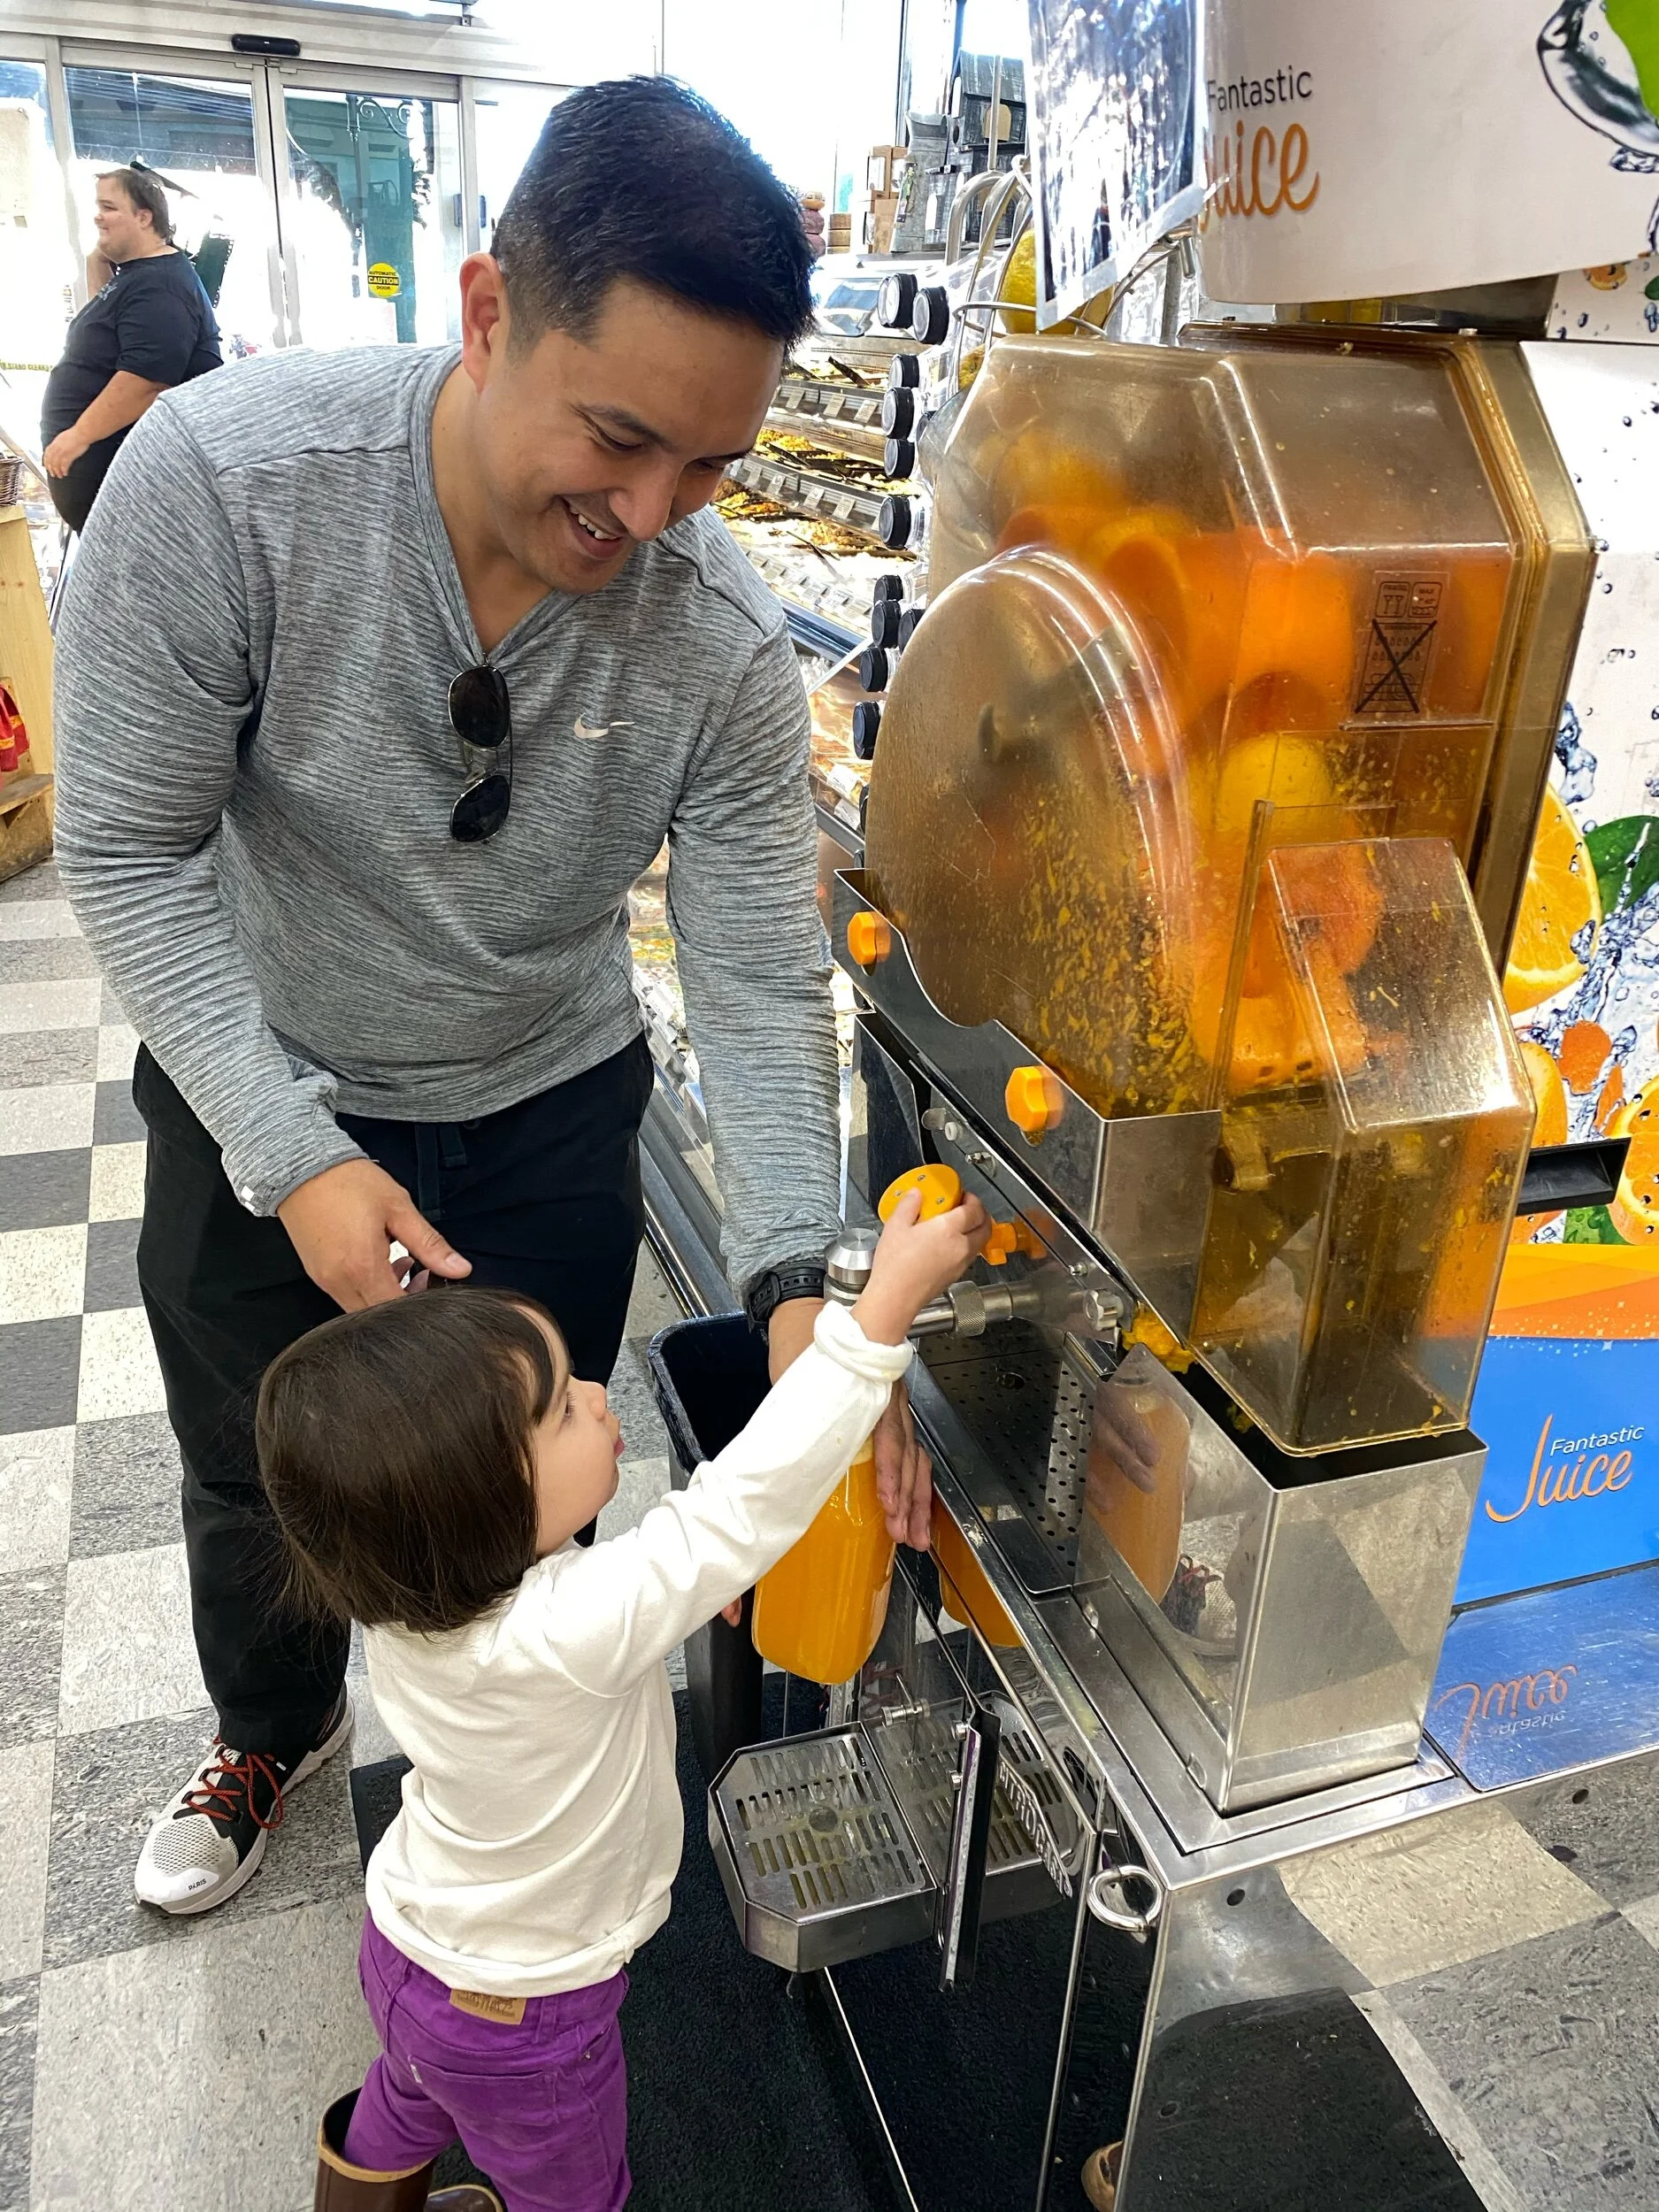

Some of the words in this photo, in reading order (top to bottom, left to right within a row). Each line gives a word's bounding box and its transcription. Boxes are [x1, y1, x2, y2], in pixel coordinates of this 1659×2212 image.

[1207, 65, 1313, 112] Fantastic
[368, 276, 399, 285] CAUTION
[1550, 1425, 1645, 1456] Fantastic
[1486, 1413, 1633, 1523] Juice
[188, 1878, 207, 1891] PARIS
